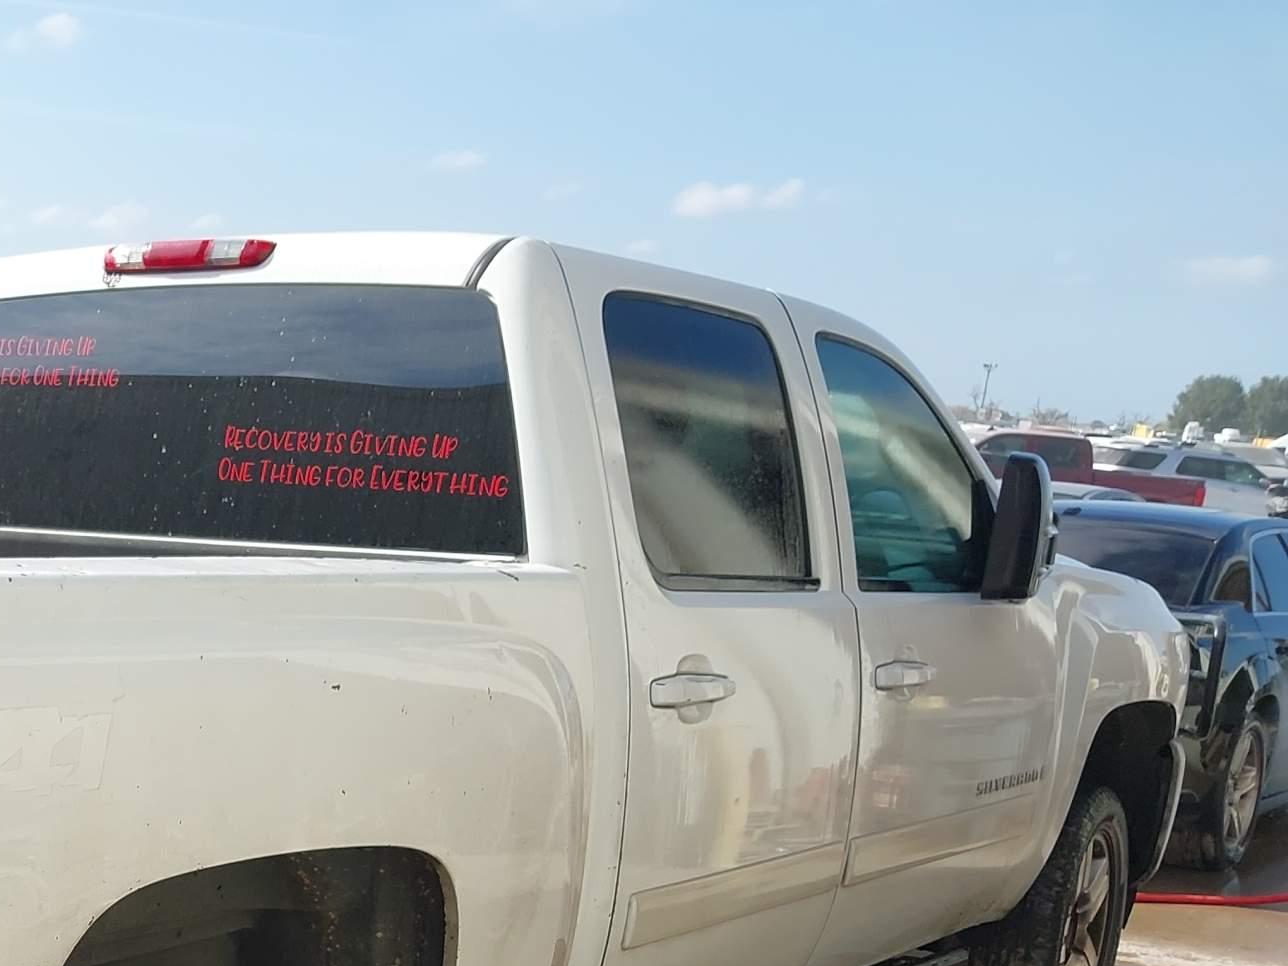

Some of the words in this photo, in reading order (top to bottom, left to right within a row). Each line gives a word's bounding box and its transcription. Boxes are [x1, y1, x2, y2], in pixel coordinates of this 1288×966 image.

[16, 336, 73, 356] GIVING
[76, 336, 96, 356] UP
[0, 367, 31, 386] FOR
[33, 365, 63, 386] ONE
[67, 365, 120, 387] THING
[224, 425, 321, 453] RECOVERY
[323, 432, 348, 454] IS
[350, 429, 427, 457] GIVING
[431, 433, 458, 459] UP
[218, 457, 254, 482] ONE
[260, 460, 321, 487] THING
[324, 466, 365, 488] FOR
[369, 465, 509, 497] EVERYTHING
